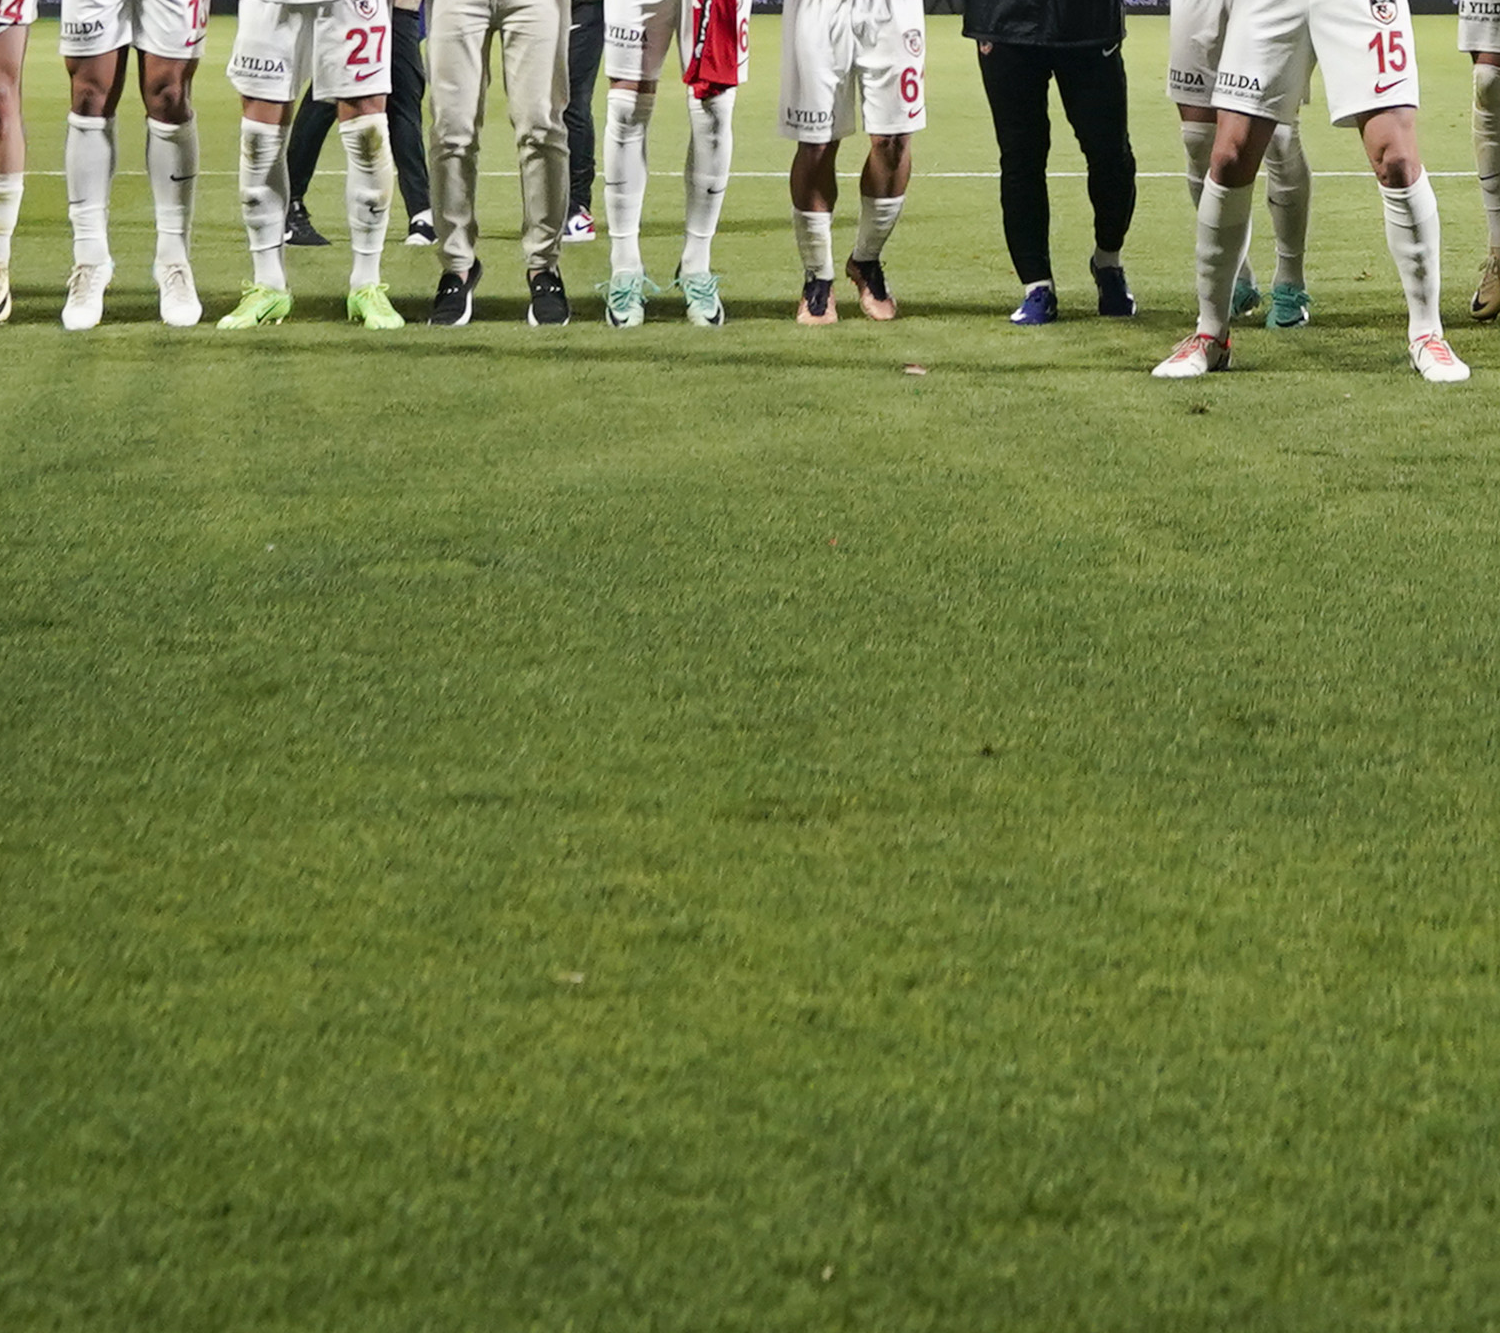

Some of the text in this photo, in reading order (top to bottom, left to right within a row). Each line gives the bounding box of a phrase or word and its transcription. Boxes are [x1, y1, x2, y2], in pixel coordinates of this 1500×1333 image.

[346, 26, 386, 65] 27
[609, 25, 648, 42] YILDA
[241, 56, 284, 73] YILDA
[1369, 31, 1407, 74] 15
[900, 67, 925, 103] 6
